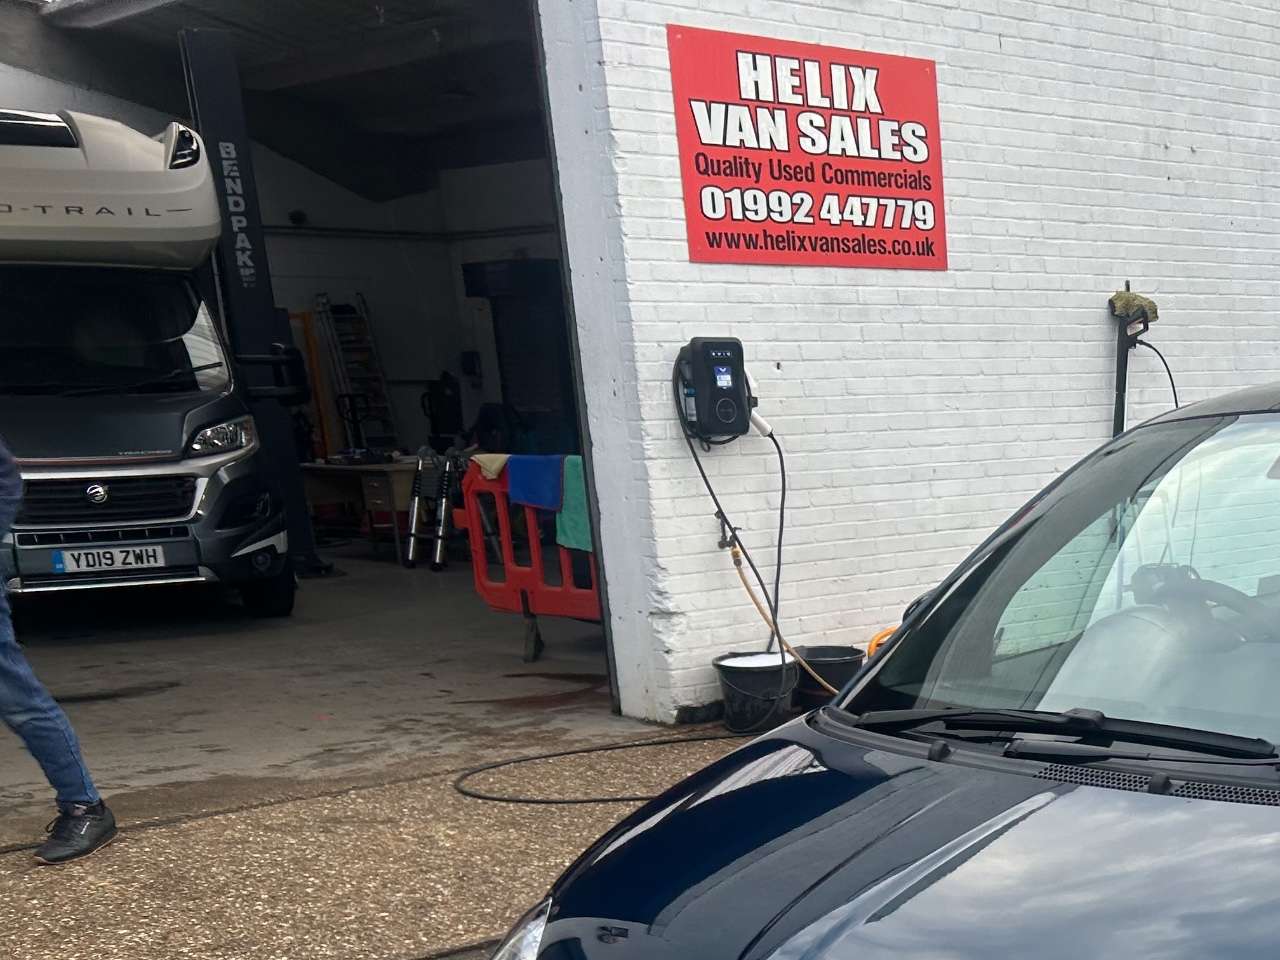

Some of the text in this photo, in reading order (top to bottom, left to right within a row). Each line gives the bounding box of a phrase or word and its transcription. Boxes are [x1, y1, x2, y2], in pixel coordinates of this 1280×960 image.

[736, 50, 884, 115] HELIX
[689, 99, 929, 163] VAN SALES
[695, 152, 932, 191] Quality Used Commercials
[219, 142, 254, 266] BENDPAK
[700, 185, 936, 230] 01992 447779
[705, 230, 936, 257] www.helixvansales.co.uk
[70, 548, 158, 568] YD19 ZWH
